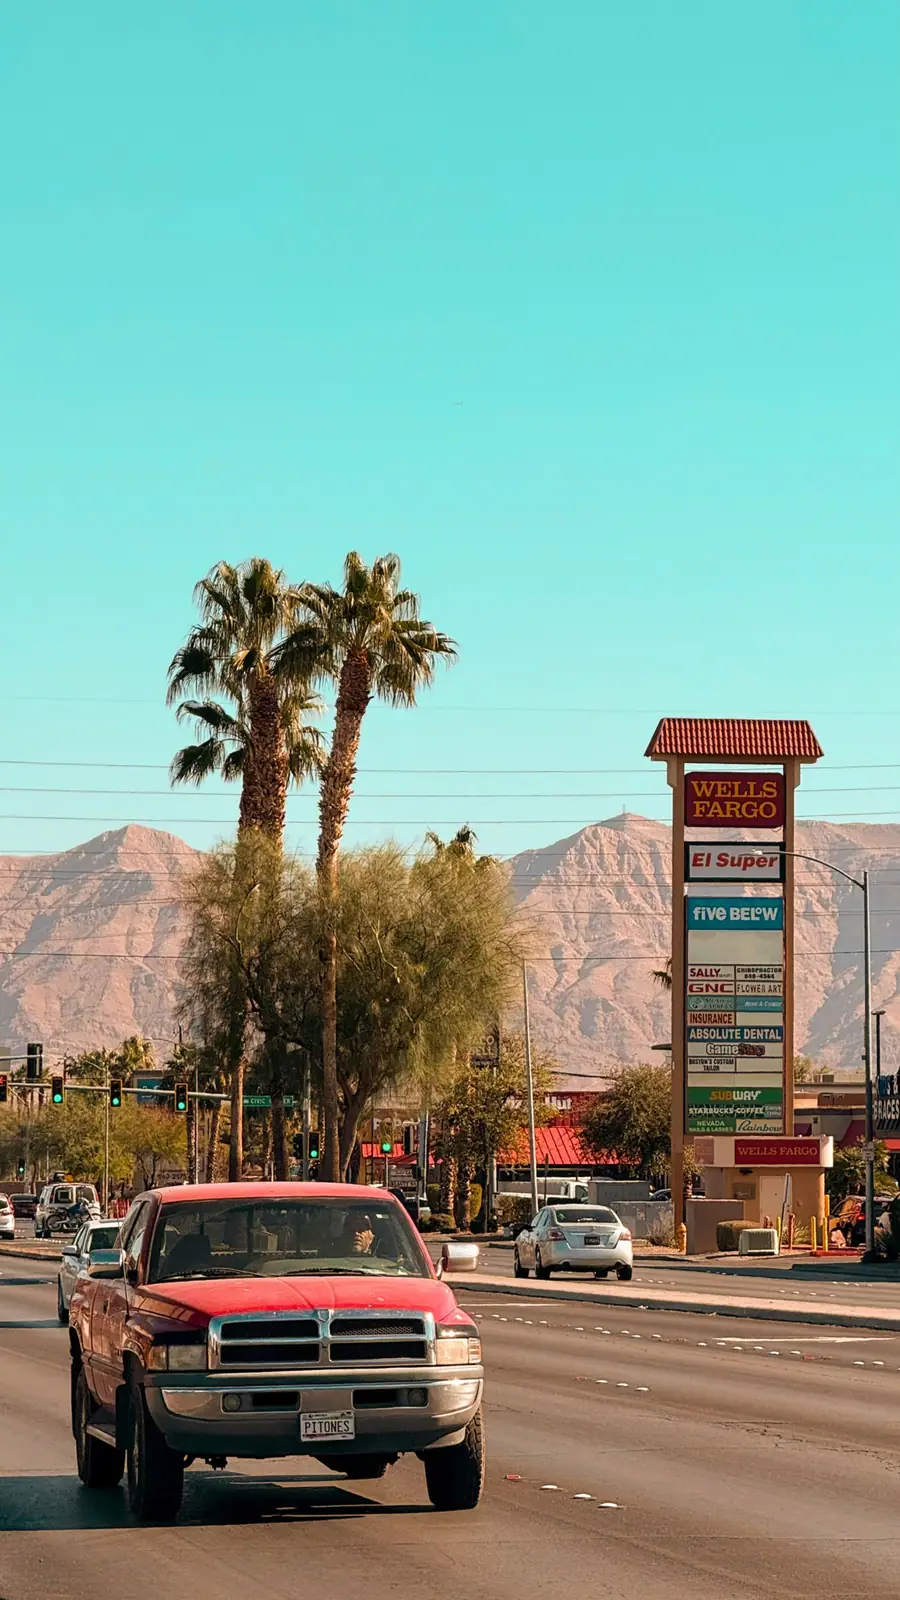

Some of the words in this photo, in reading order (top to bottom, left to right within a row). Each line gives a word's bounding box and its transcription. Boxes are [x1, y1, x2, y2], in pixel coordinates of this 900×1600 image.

[691, 780, 777, 798] WELLS
[693, 801, 777, 818] FARGO
[692, 853, 711, 867] El
[716, 853, 777, 870] Super
[693, 907, 727, 921] five
[730, 907, 778, 921] BELOW
[690, 968, 720, 977] SALLY
[689, 984, 733, 993] GNC
[737, 985, 766, 993] FLOWER
[768, 985, 782, 993] ART
[690, 1013, 732, 1024] INSURANCE
[690, 1029, 741, 1039] ABSOLUTE
[744, 1029, 781, 1039] DENTAL
[706, 1043, 765, 1056] GameStop
[711, 1090, 761, 1101] SUBWAY
[873, 1100, 900, 1120] BRACES
[738, 1120, 782, 1132] Rainbow
[737, 1147, 777, 1156] WELLS
[780, 1147, 818, 1156] FARGO
[304, 1421, 350, 1433] PITONES
